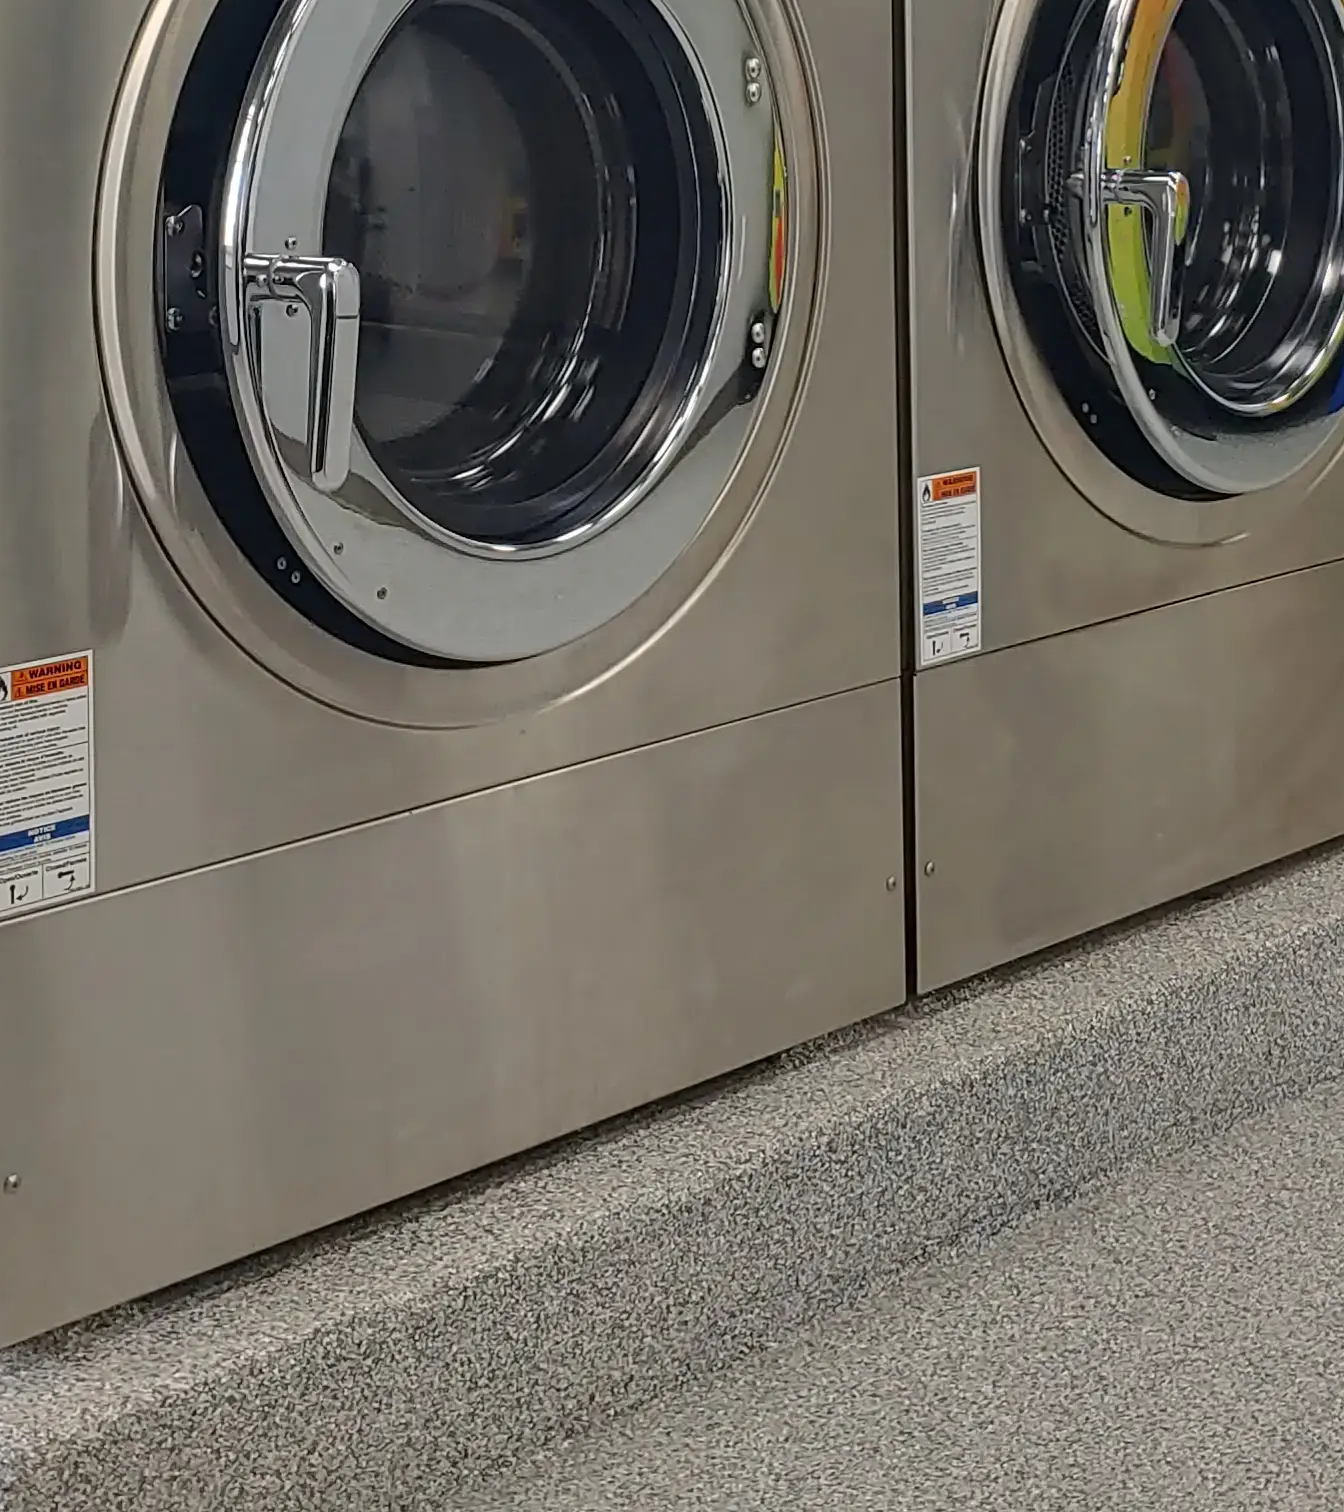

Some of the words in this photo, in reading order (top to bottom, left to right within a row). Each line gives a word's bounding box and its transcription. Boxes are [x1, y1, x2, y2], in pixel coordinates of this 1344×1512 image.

[29, 660, 82, 680] WARNING
[26, 683, 45, 694] MISE
[48, 680, 57, 690] EN
[59, 674, 85, 687] GARDE
[28, 824, 56, 836] NOTICE
